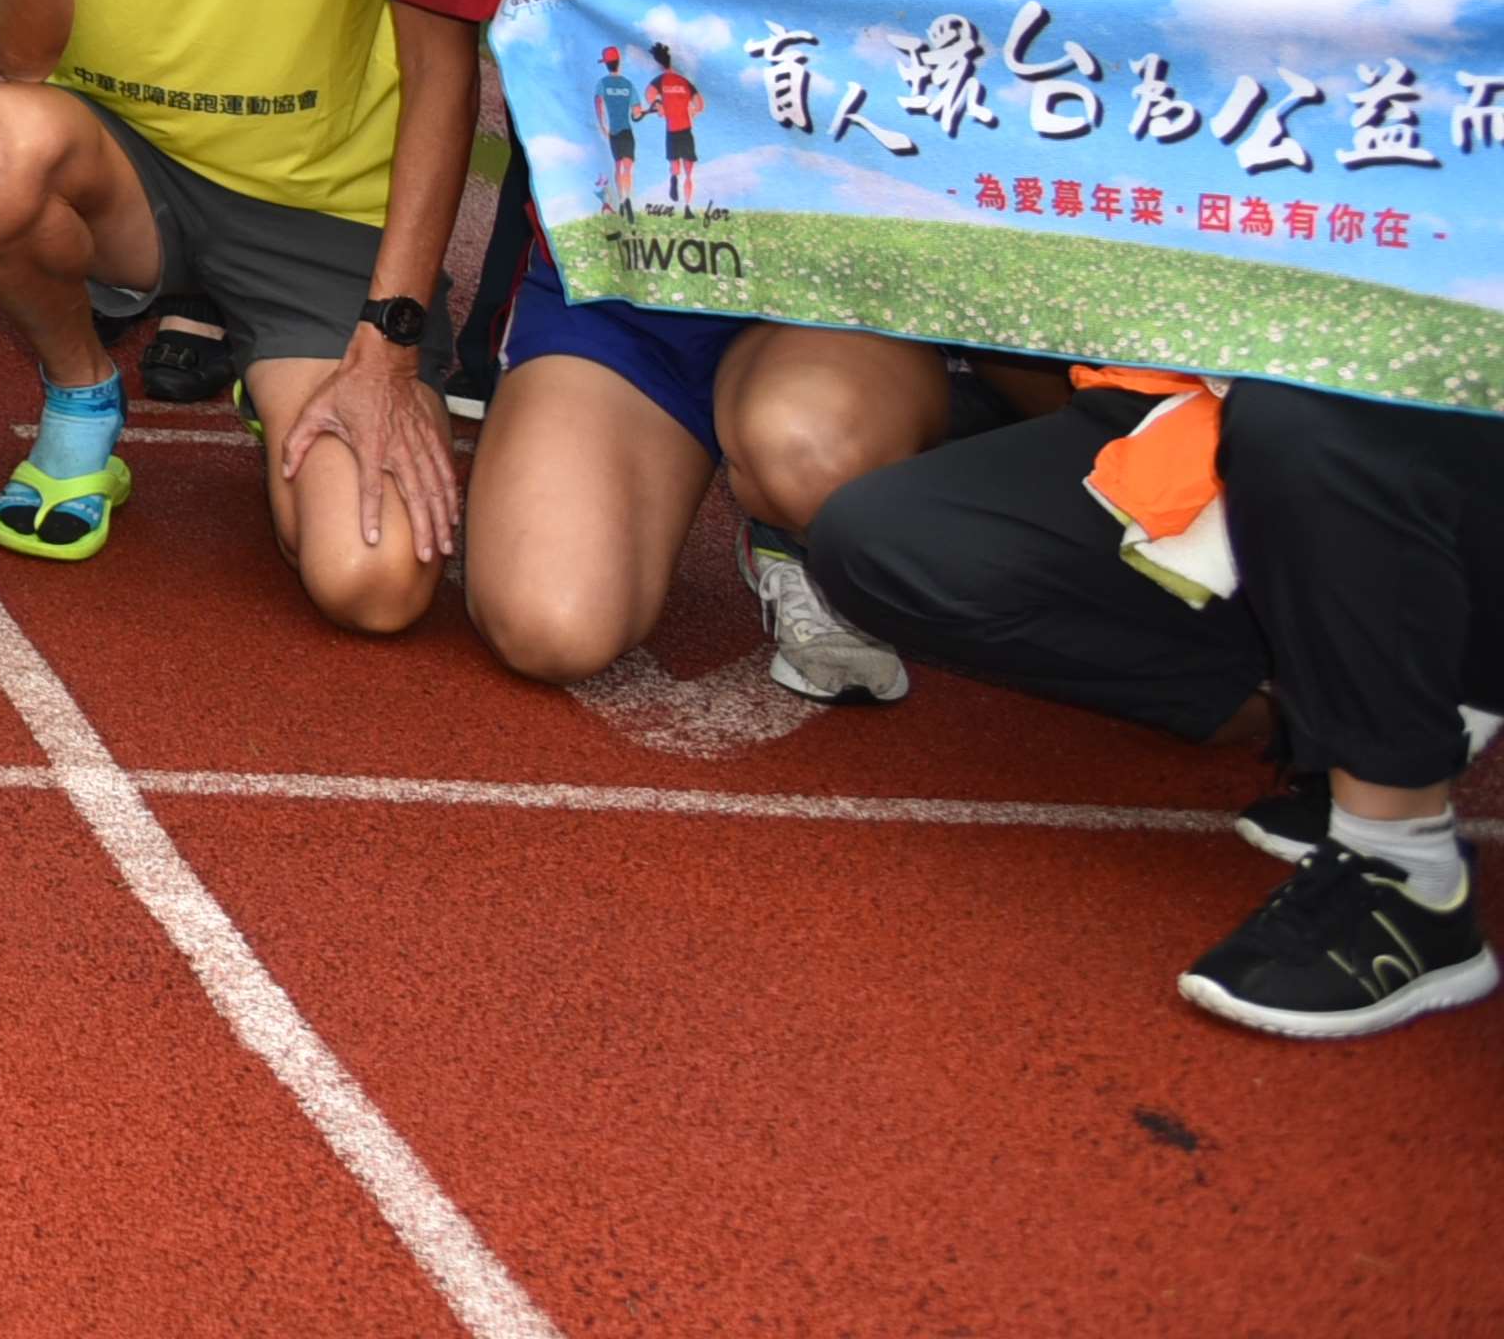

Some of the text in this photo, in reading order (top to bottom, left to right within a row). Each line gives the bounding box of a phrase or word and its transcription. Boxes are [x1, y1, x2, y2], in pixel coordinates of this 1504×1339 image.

[73, 66, 319, 117] 中華視障路跑運動協會
[645, 200, 731, 228] run for
[606, 230, 743, 278] Tiwan
